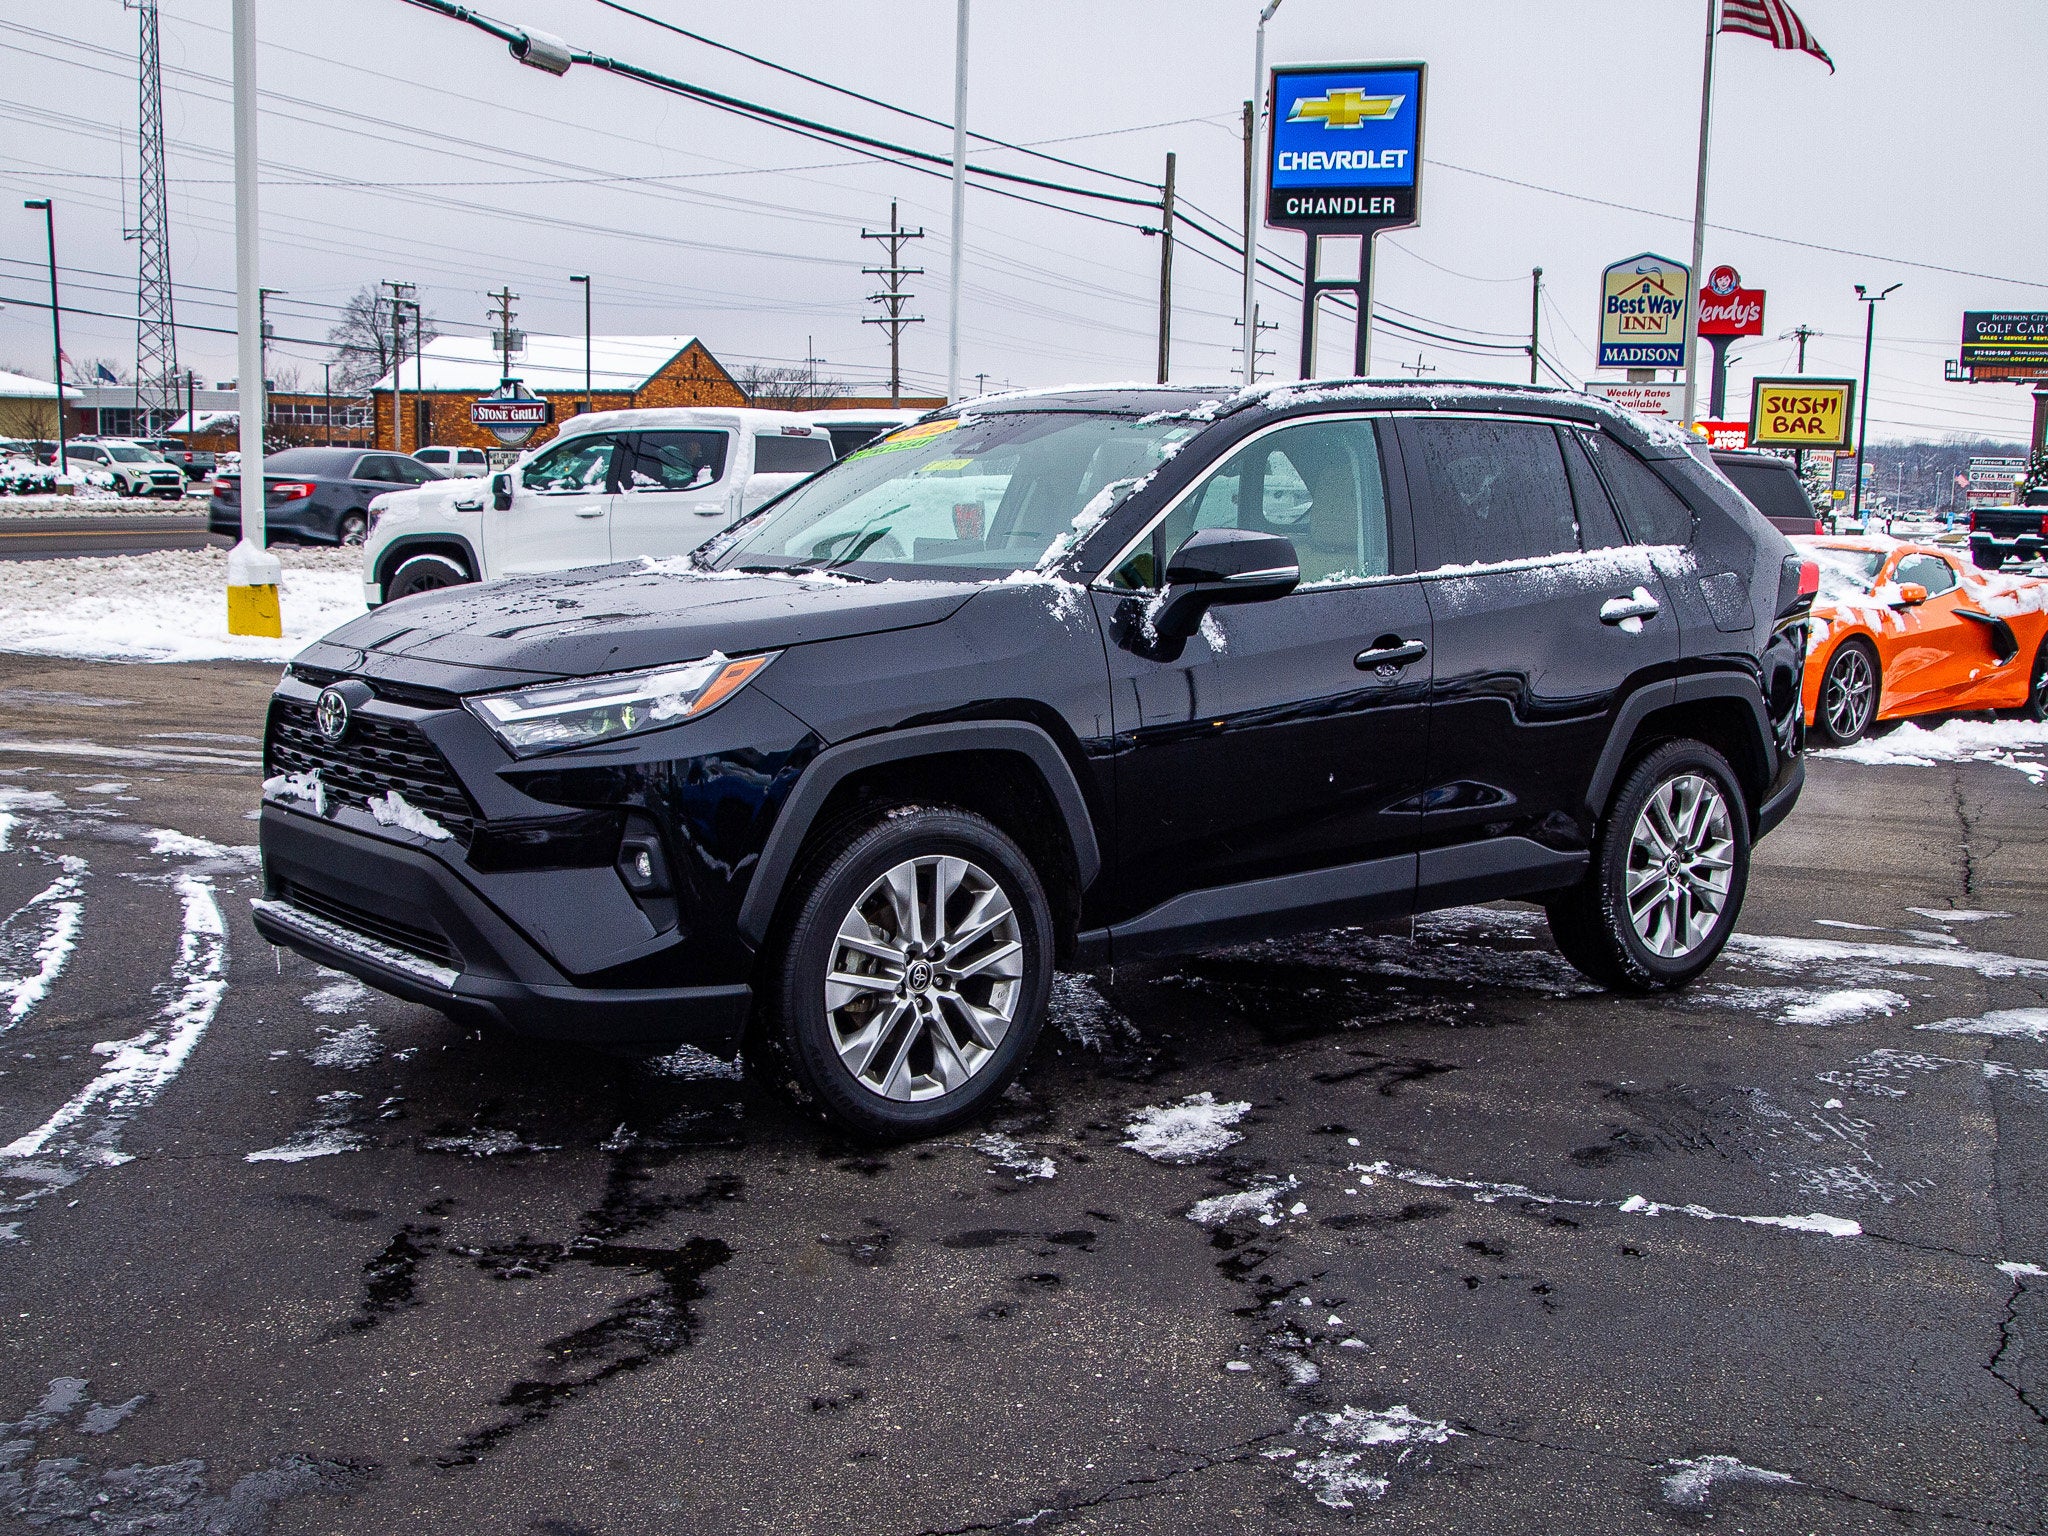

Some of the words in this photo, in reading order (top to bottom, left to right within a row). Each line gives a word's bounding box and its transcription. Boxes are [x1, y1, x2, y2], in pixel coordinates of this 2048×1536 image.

[1278, 150, 1408, 170] CHEVROLET
[1286, 197, 1396, 214] CHANDLER
[1607, 295, 1645, 314] Best
[1647, 295, 1683, 320] Way
[1623, 316, 1664, 330] INN
[1976, 321, 2012, 333] GOLF
[2017, 322, 2048, 333] CAR
[1603, 348, 1680, 361] MADISON
[1607, 388, 1641, 398] Weekly
[1644, 389, 1671, 397] Rates
[479, 406, 508, 420] STONE
[511, 407, 539, 420] GRILL
[1766, 396, 1837, 415] SUSHI
[1773, 416, 1825, 434] BAR
